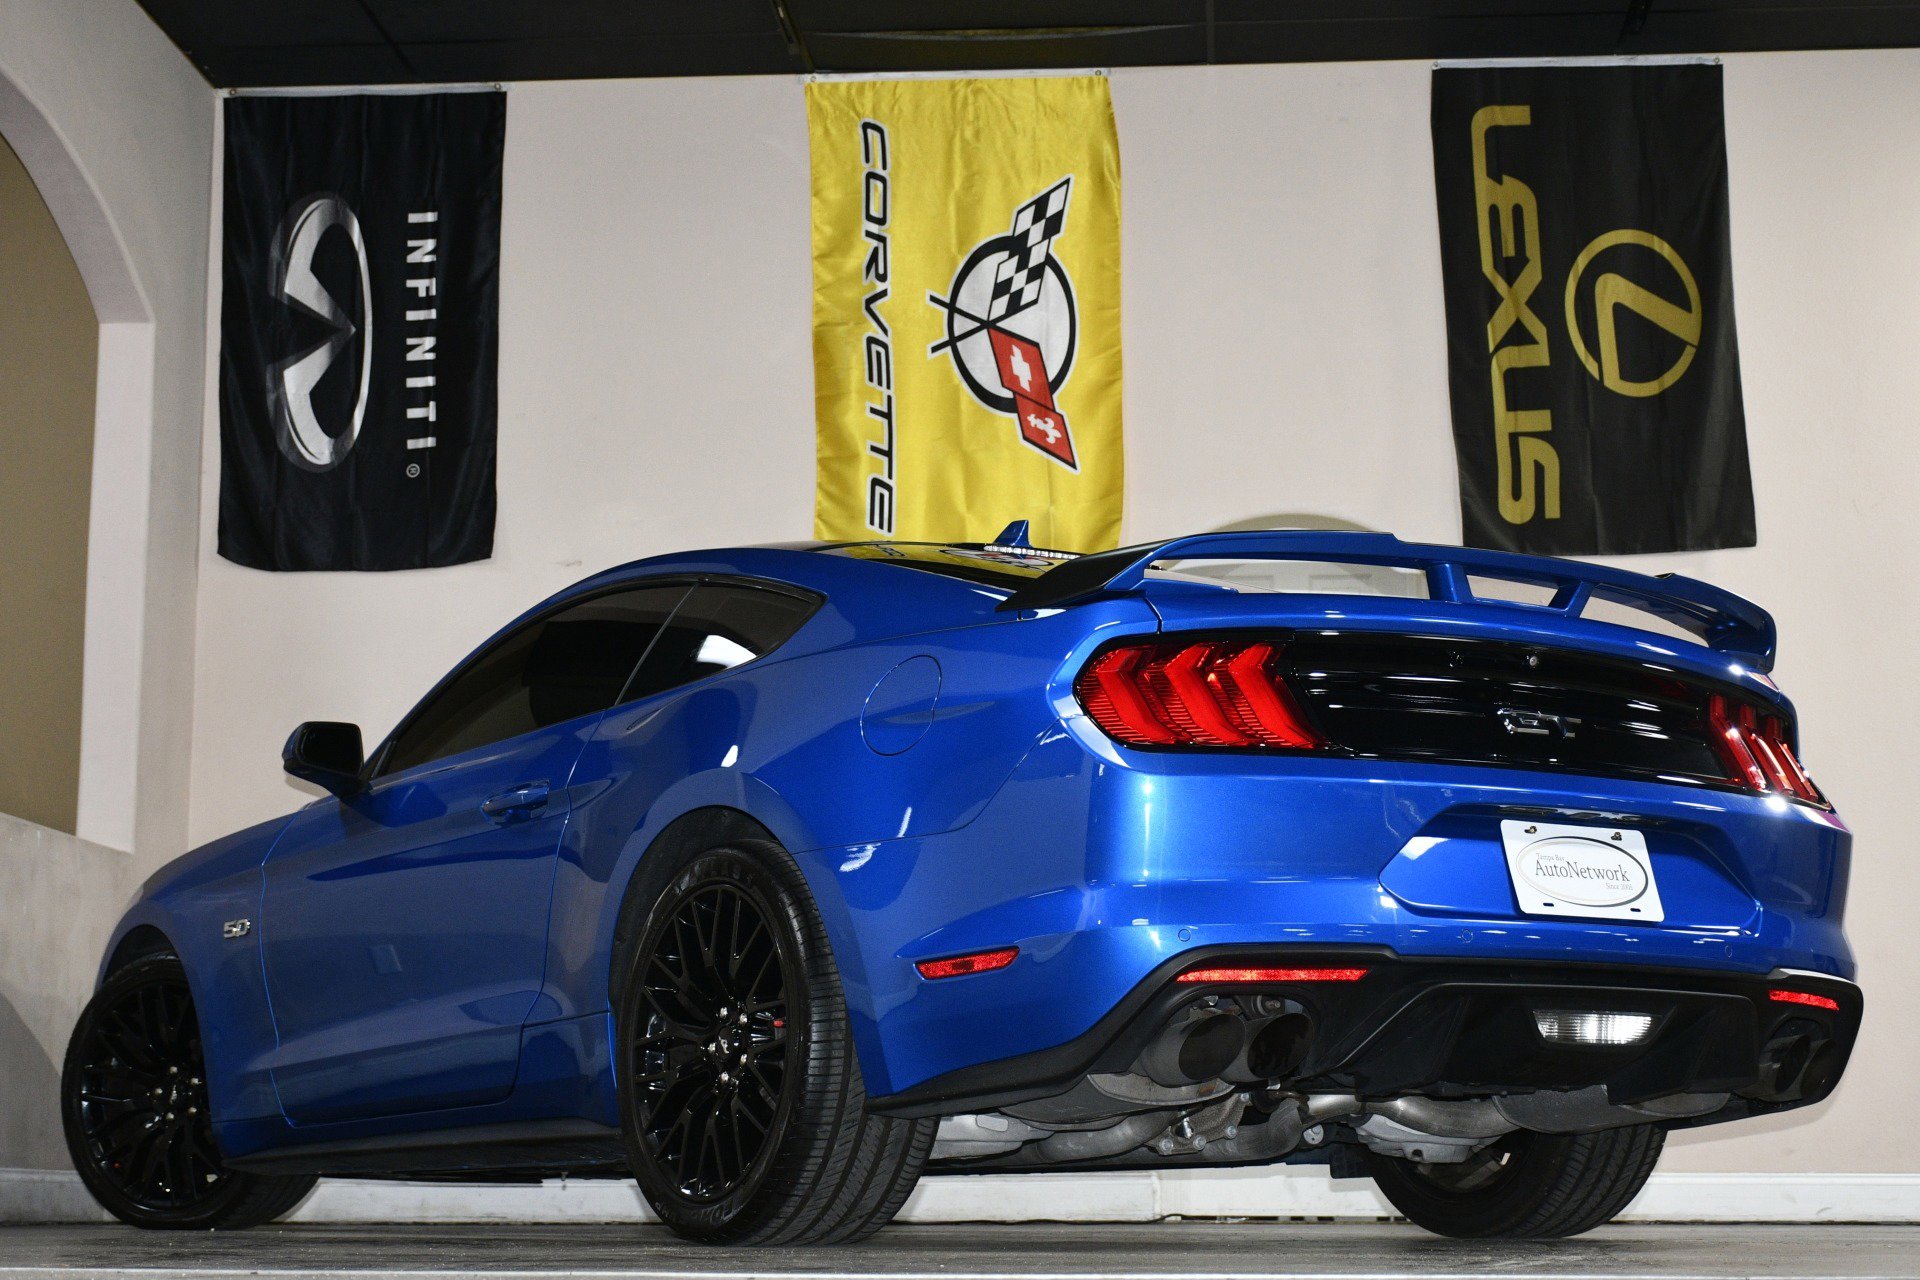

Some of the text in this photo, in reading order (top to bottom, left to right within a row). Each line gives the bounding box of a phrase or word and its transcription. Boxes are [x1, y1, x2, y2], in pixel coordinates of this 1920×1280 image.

[405, 211, 438, 450] INFINITI
[860, 119, 895, 535] CORVETTE
[1470, 104, 1561, 525] LEXUS
[1496, 706, 1582, 738] GT
[1535, 859, 1631, 883] AutoNetwork
